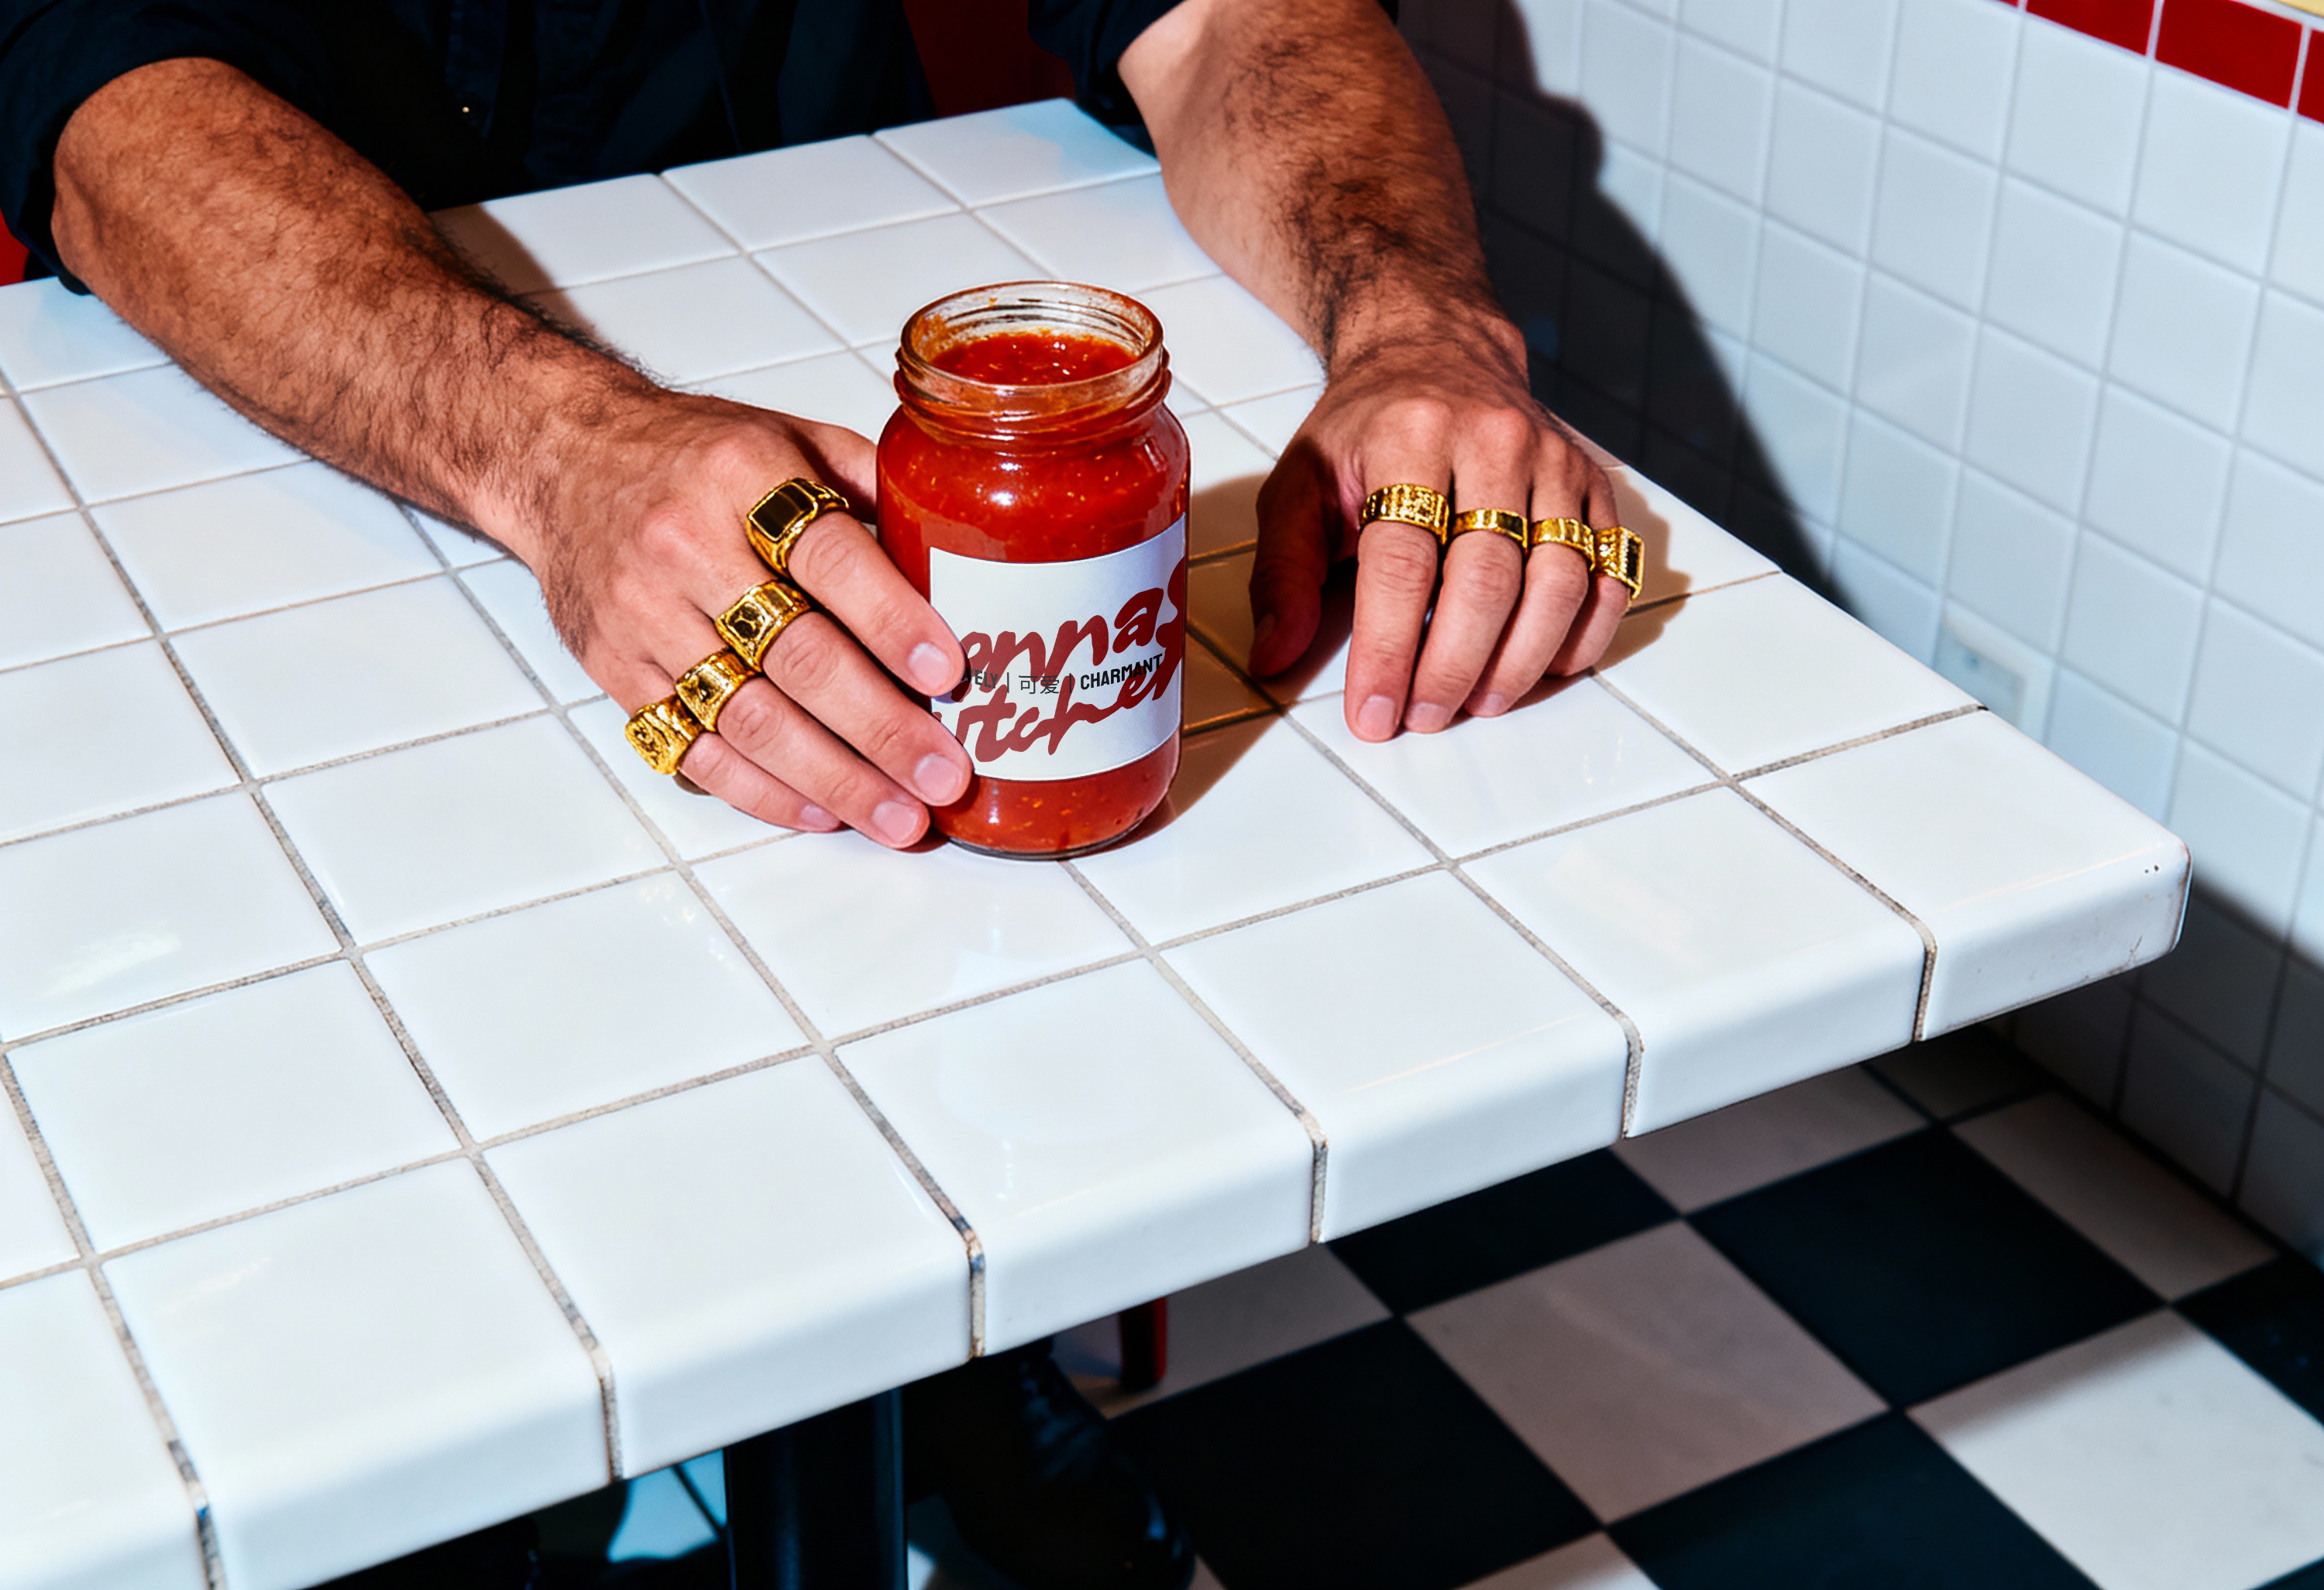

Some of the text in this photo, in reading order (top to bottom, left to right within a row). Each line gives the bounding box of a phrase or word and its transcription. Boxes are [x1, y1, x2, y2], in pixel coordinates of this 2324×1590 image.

[962, 668, 999, 689] VELY
[1018, 675, 1060, 695] 可爱
[1080, 653, 1163, 690] CHARMANT
